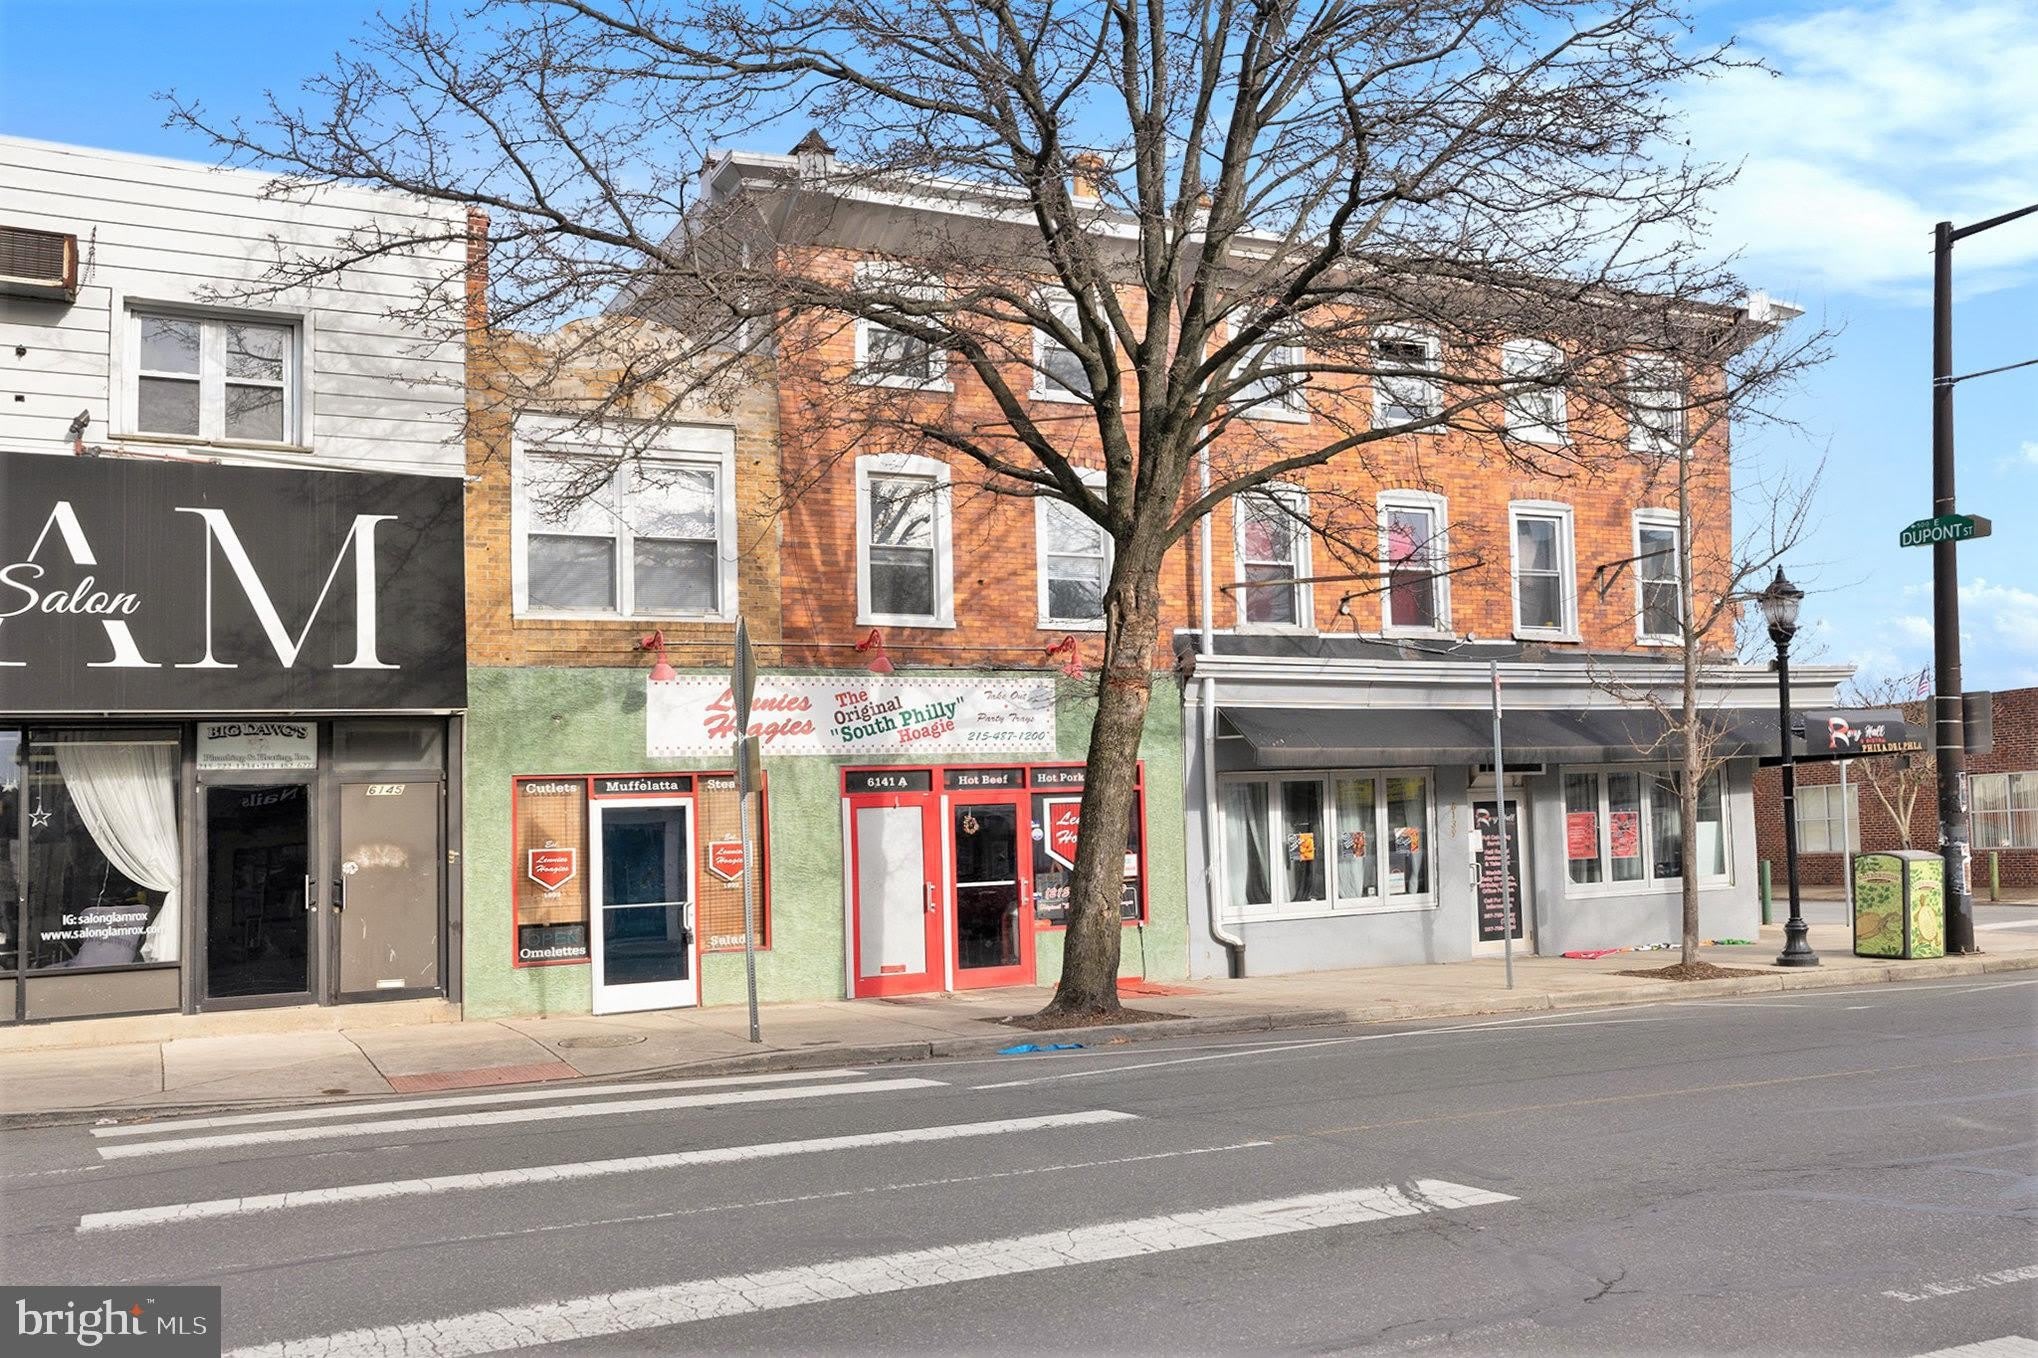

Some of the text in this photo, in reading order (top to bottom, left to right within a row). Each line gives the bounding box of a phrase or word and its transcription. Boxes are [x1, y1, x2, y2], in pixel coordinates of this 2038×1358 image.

[1933, 518, 1940, 527] E
[1902, 523, 1973, 546] DUPONT ST
[0, 562, 141, 618] Salon
[835, 689, 869, 708] The
[984, 690, 1028, 701] Take Out
[833, 696, 903, 725] Original
[830, 696, 964, 743] "South Philly"
[976, 712, 1035, 723] Party Trays
[207, 724, 242, 740] BIG
[703, 713, 816, 744] Hagies
[897, 718, 956, 744] Hoagie
[967, 731, 1046, 741] 215-487-1200
[867, 776, 908, 788] 6141 A
[958, 774, 1009, 786] Hot Beef
[1037, 773, 1085, 783] Hot Pork
[368, 785, 403, 795] 6145
[525, 783, 578, 794] Cutlets
[606, 780, 679, 792] Muffelatta
[707, 779, 736, 790] Stea
[62, 911, 148, 926] IG: salonglamrox
[519, 946, 587, 959] Omelettes
